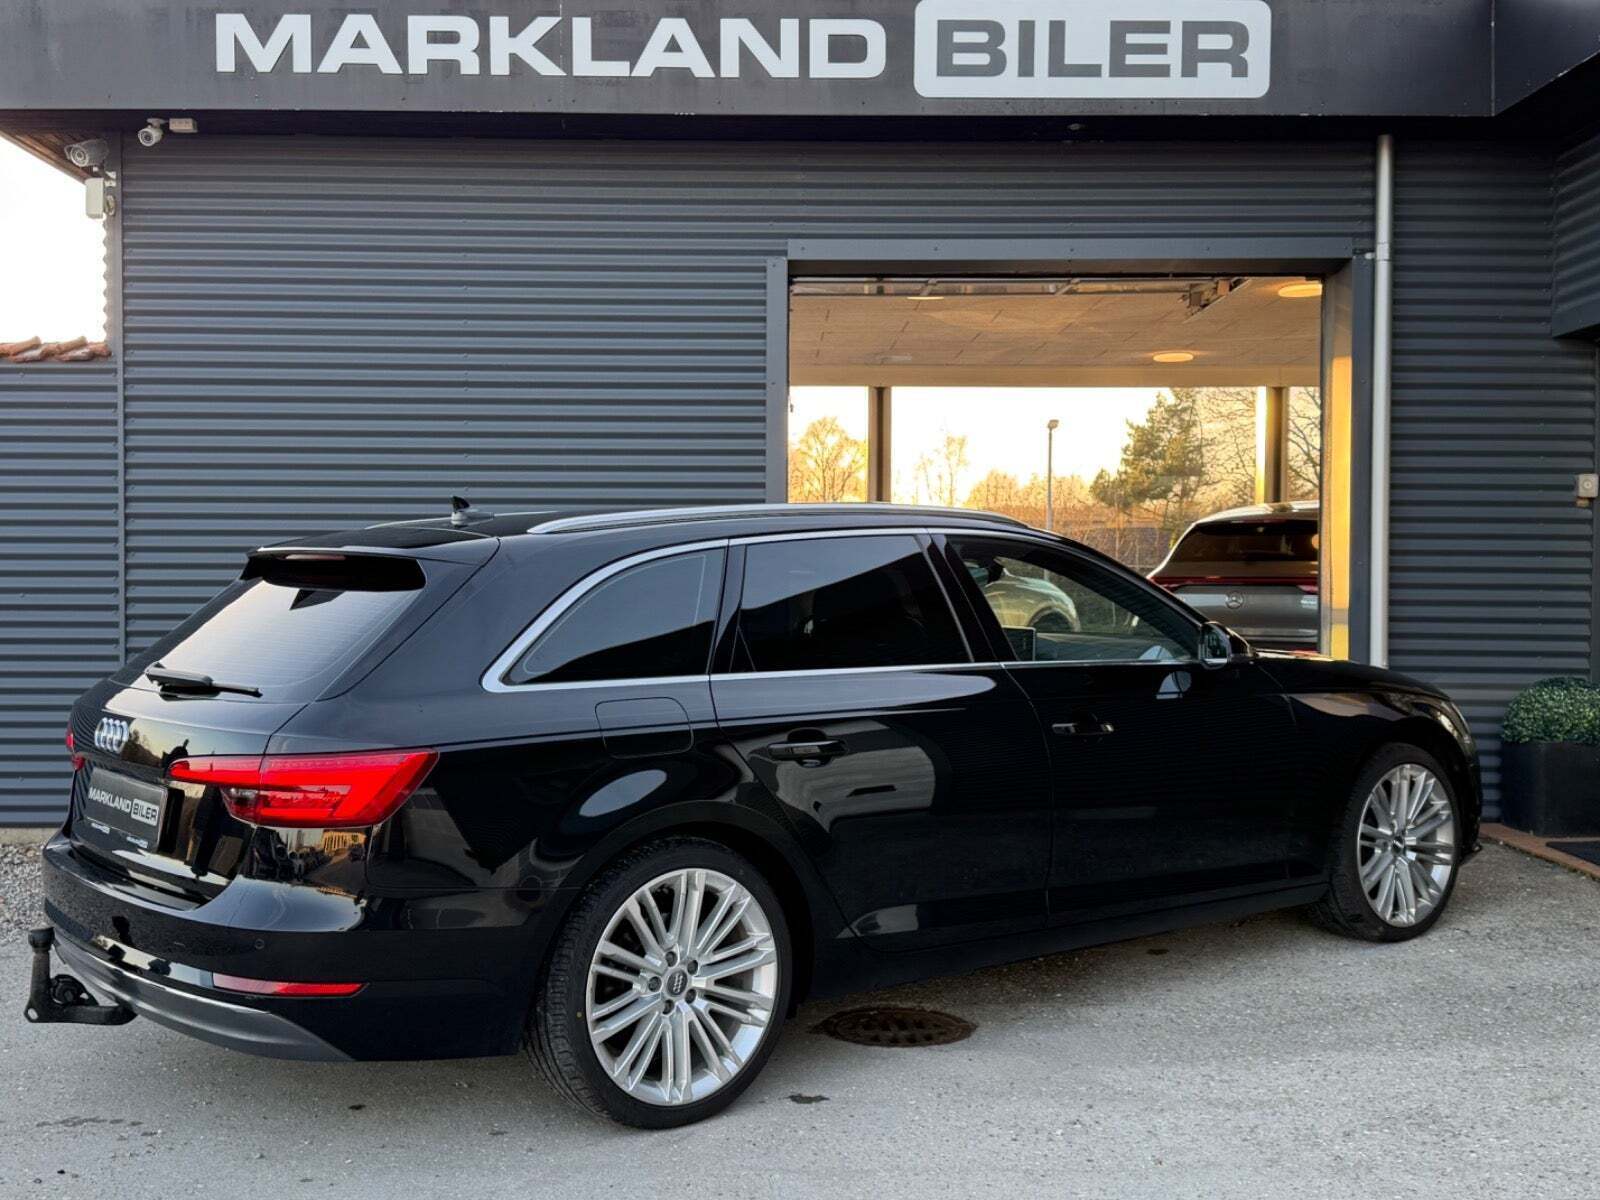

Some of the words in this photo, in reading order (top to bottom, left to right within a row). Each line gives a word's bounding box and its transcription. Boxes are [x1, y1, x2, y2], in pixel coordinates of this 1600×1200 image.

[215, 13, 887, 79] MARKLAND
[936, 19, 1250, 79] BILER
[88, 787, 131, 813] MARKLAND
[132, 802, 158, 821] BILER
